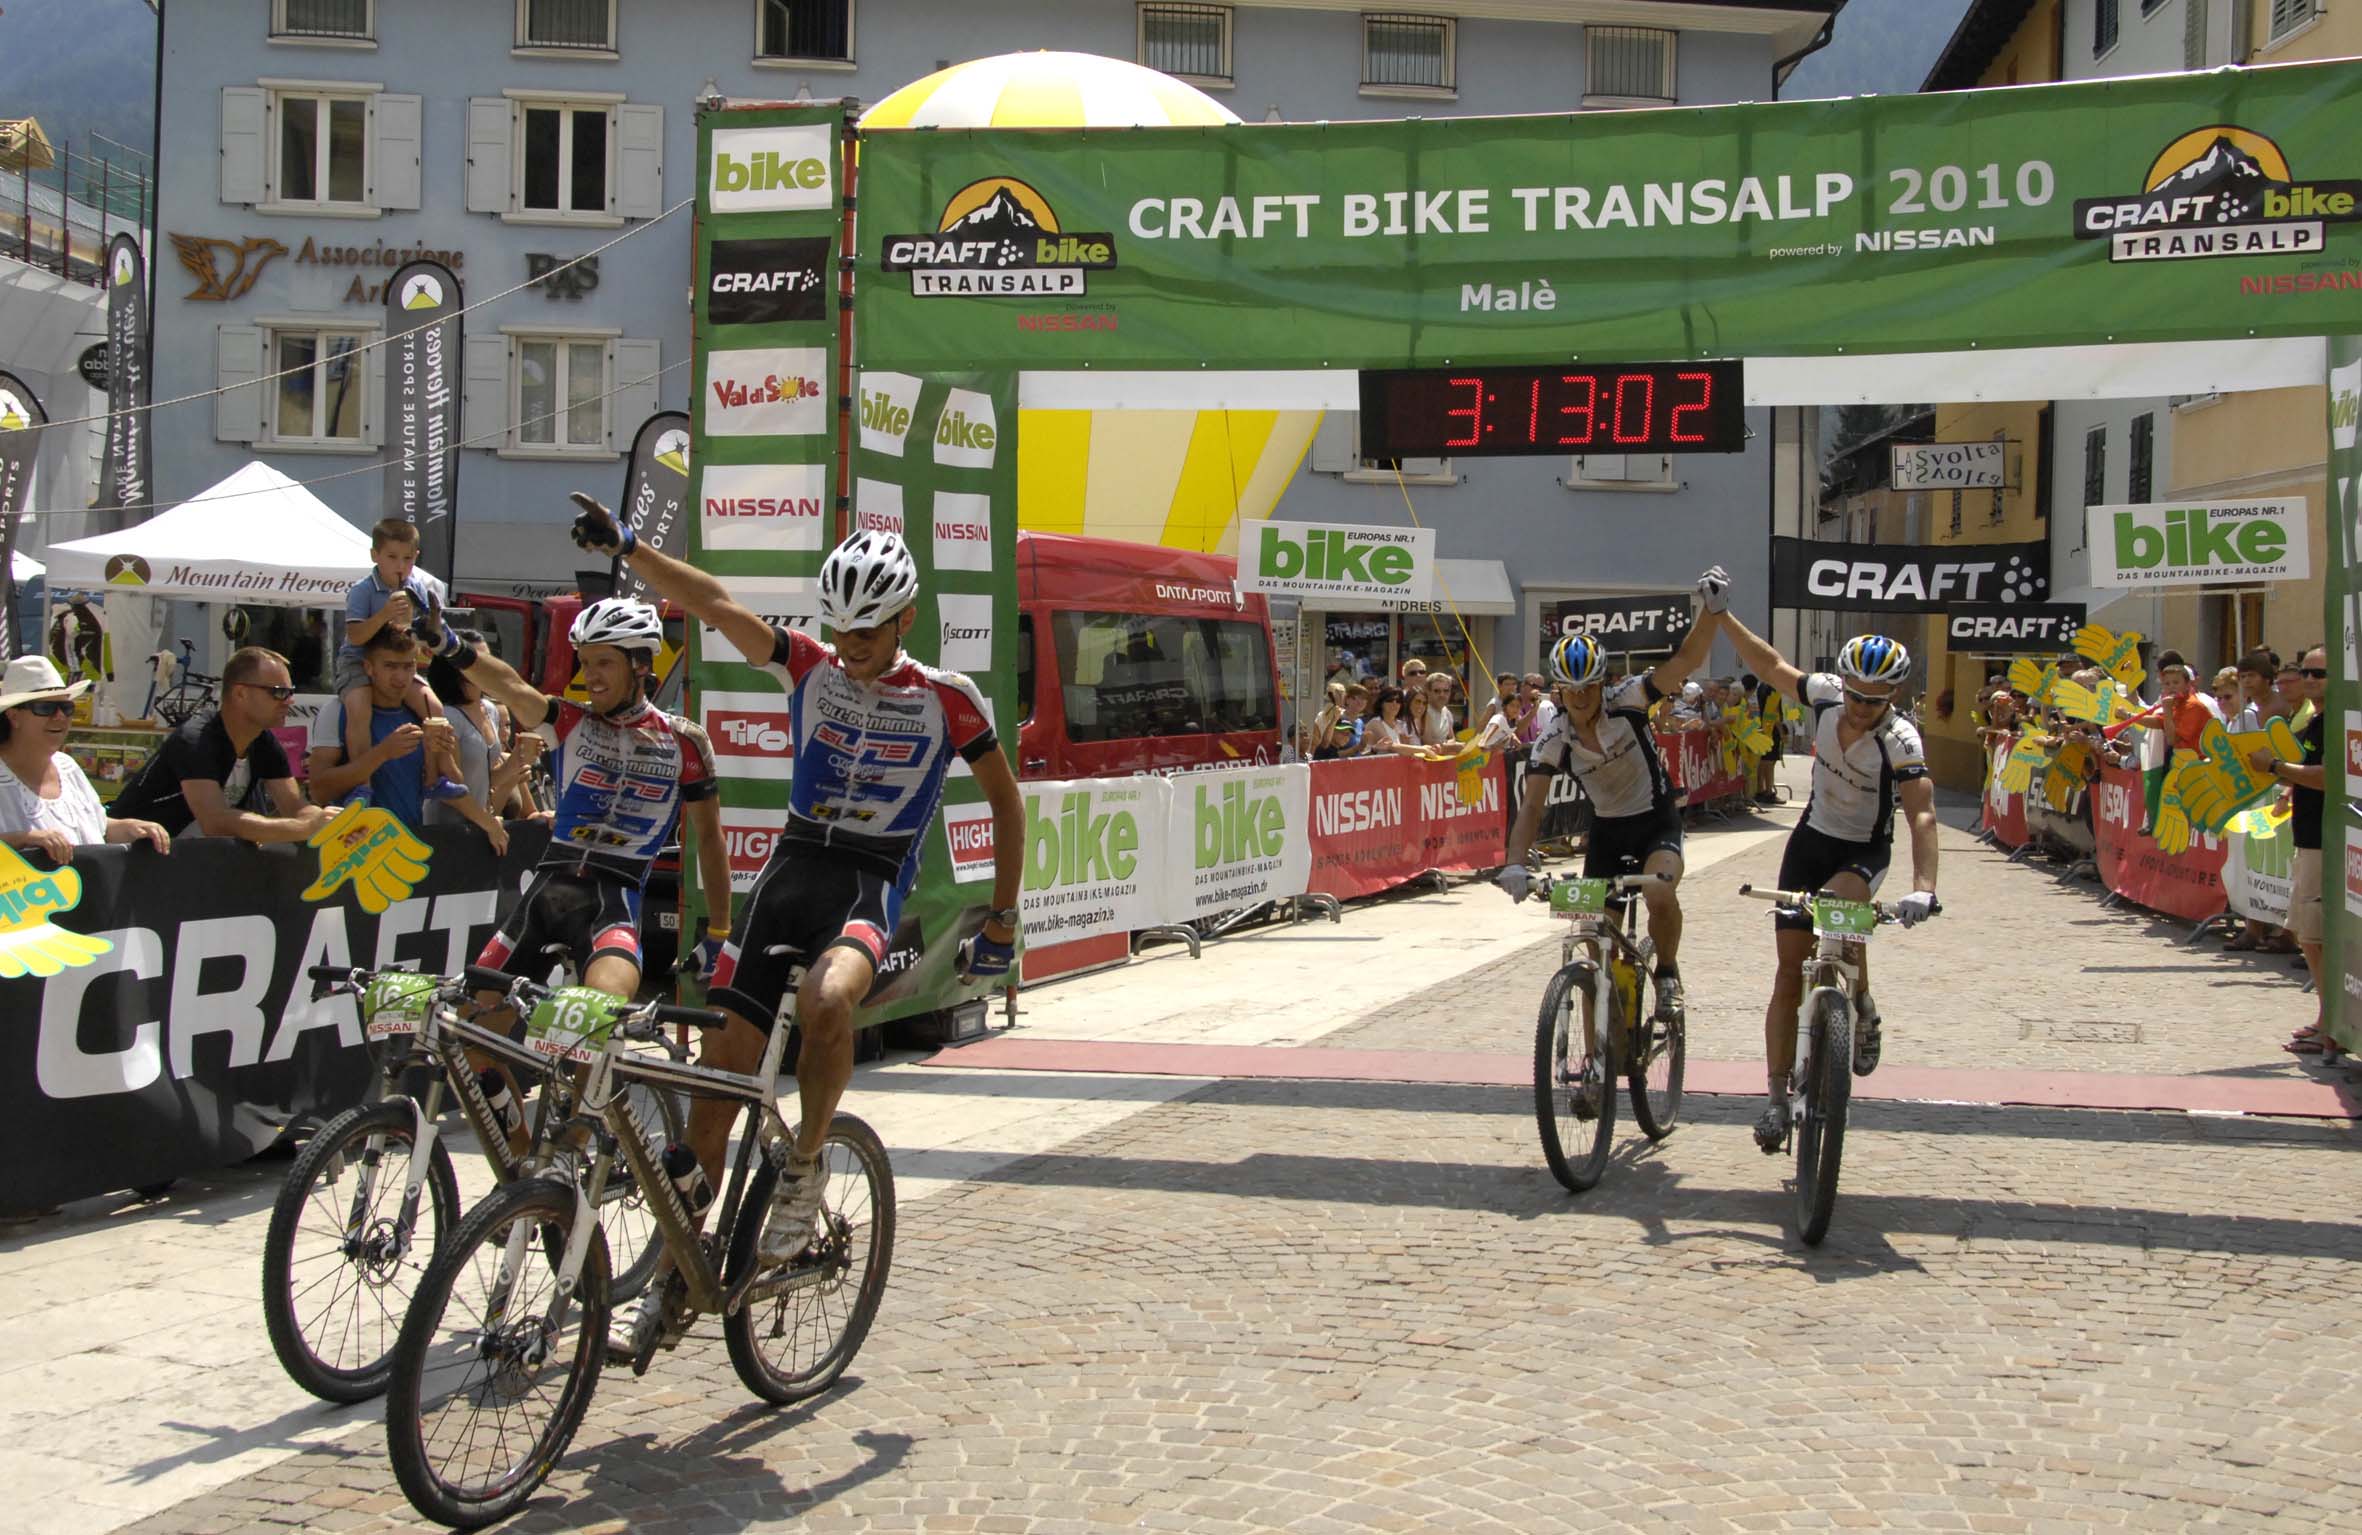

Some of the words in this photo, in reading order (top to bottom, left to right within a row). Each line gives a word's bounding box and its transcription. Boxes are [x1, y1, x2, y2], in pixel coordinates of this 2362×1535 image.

[715, 151, 826, 192] bike
[1128, 195, 1320, 239] CRAFT
[1344, 189, 1490, 237] BIKE
[1511, 172, 1854, 231] TRANSALP
[1888, 160, 2055, 215] 2010
[2085, 195, 2214, 230] CRAFT
[2263, 187, 2356, 218] bike
[889, 241, 996, 264] CRAFT
[1036, 238, 1110, 264] bike
[1769, 244, 1826, 259] powered
[1828, 243, 1843, 257] by
[1855, 226, 1995, 253] NISSAN
[2123, 230, 2311, 257] TRANSALP
[712, 271, 801, 293] CRAFT
[920, 274, 1075, 293] TRANSALP
[1460, 279, 1557, 311] Malè
[1018, 314, 1119, 332] NISSAN
[860, 388, 910, 437] bike
[936, 409, 996, 450] bike
[1915, 443, 2000, 468] Svolta
[705, 498, 820, 517] NISSAN
[2209, 507, 2259, 518] EUROPAS
[2260, 506, 2285, 517] NR.1
[1347, 532, 1392, 543] EUROPAS
[1394, 534, 1416, 544] NR.1
[2113, 508, 2288, 570] bike
[1258, 527, 1415, 585] bike
[165, 565, 275, 590] Mountain
[1807, 559, 1996, 600] CRAFT
[2117, 572, 2139, 581] DAS
[2144, 565, 2288, 579] MOUNTAINBIKE-MAGAZIN
[1257, 580, 1278, 588] DAS
[1283, 581, 1412, 595] MOUNTAINBIKE-MAGAZIN
[950, 629, 991, 640] SCOTT
[1562, 609, 1663, 635] CRAFT
[1951, 616, 2057, 638] CRAFT
[2212, 734, 2255, 801] bike
[1315, 787, 1402, 837] NISSAN
[1419, 776, 1499, 822] NISN
[1194, 780, 1286, 870] bike
[1023, 791, 1139, 892] bike
[321, 822, 400, 888] bike
[1023, 898, 1041, 911] DAS
[1566, 887, 1581, 903] 9
[1556, 912, 1597, 921] NISSAN
[1830, 910, 1845, 924] 9
[878, 951, 908, 974] AFT
[36, 889, 500, 1099] CRAFT
[375, 985, 402, 1009] 16
[403, 995, 415, 1008] 2
[369, 1023, 412, 1033] NISSAN
[553, 998, 588, 1030] 16
[589, 1017, 598, 1033] 1
[534, 1040, 592, 1061] NISSAN
